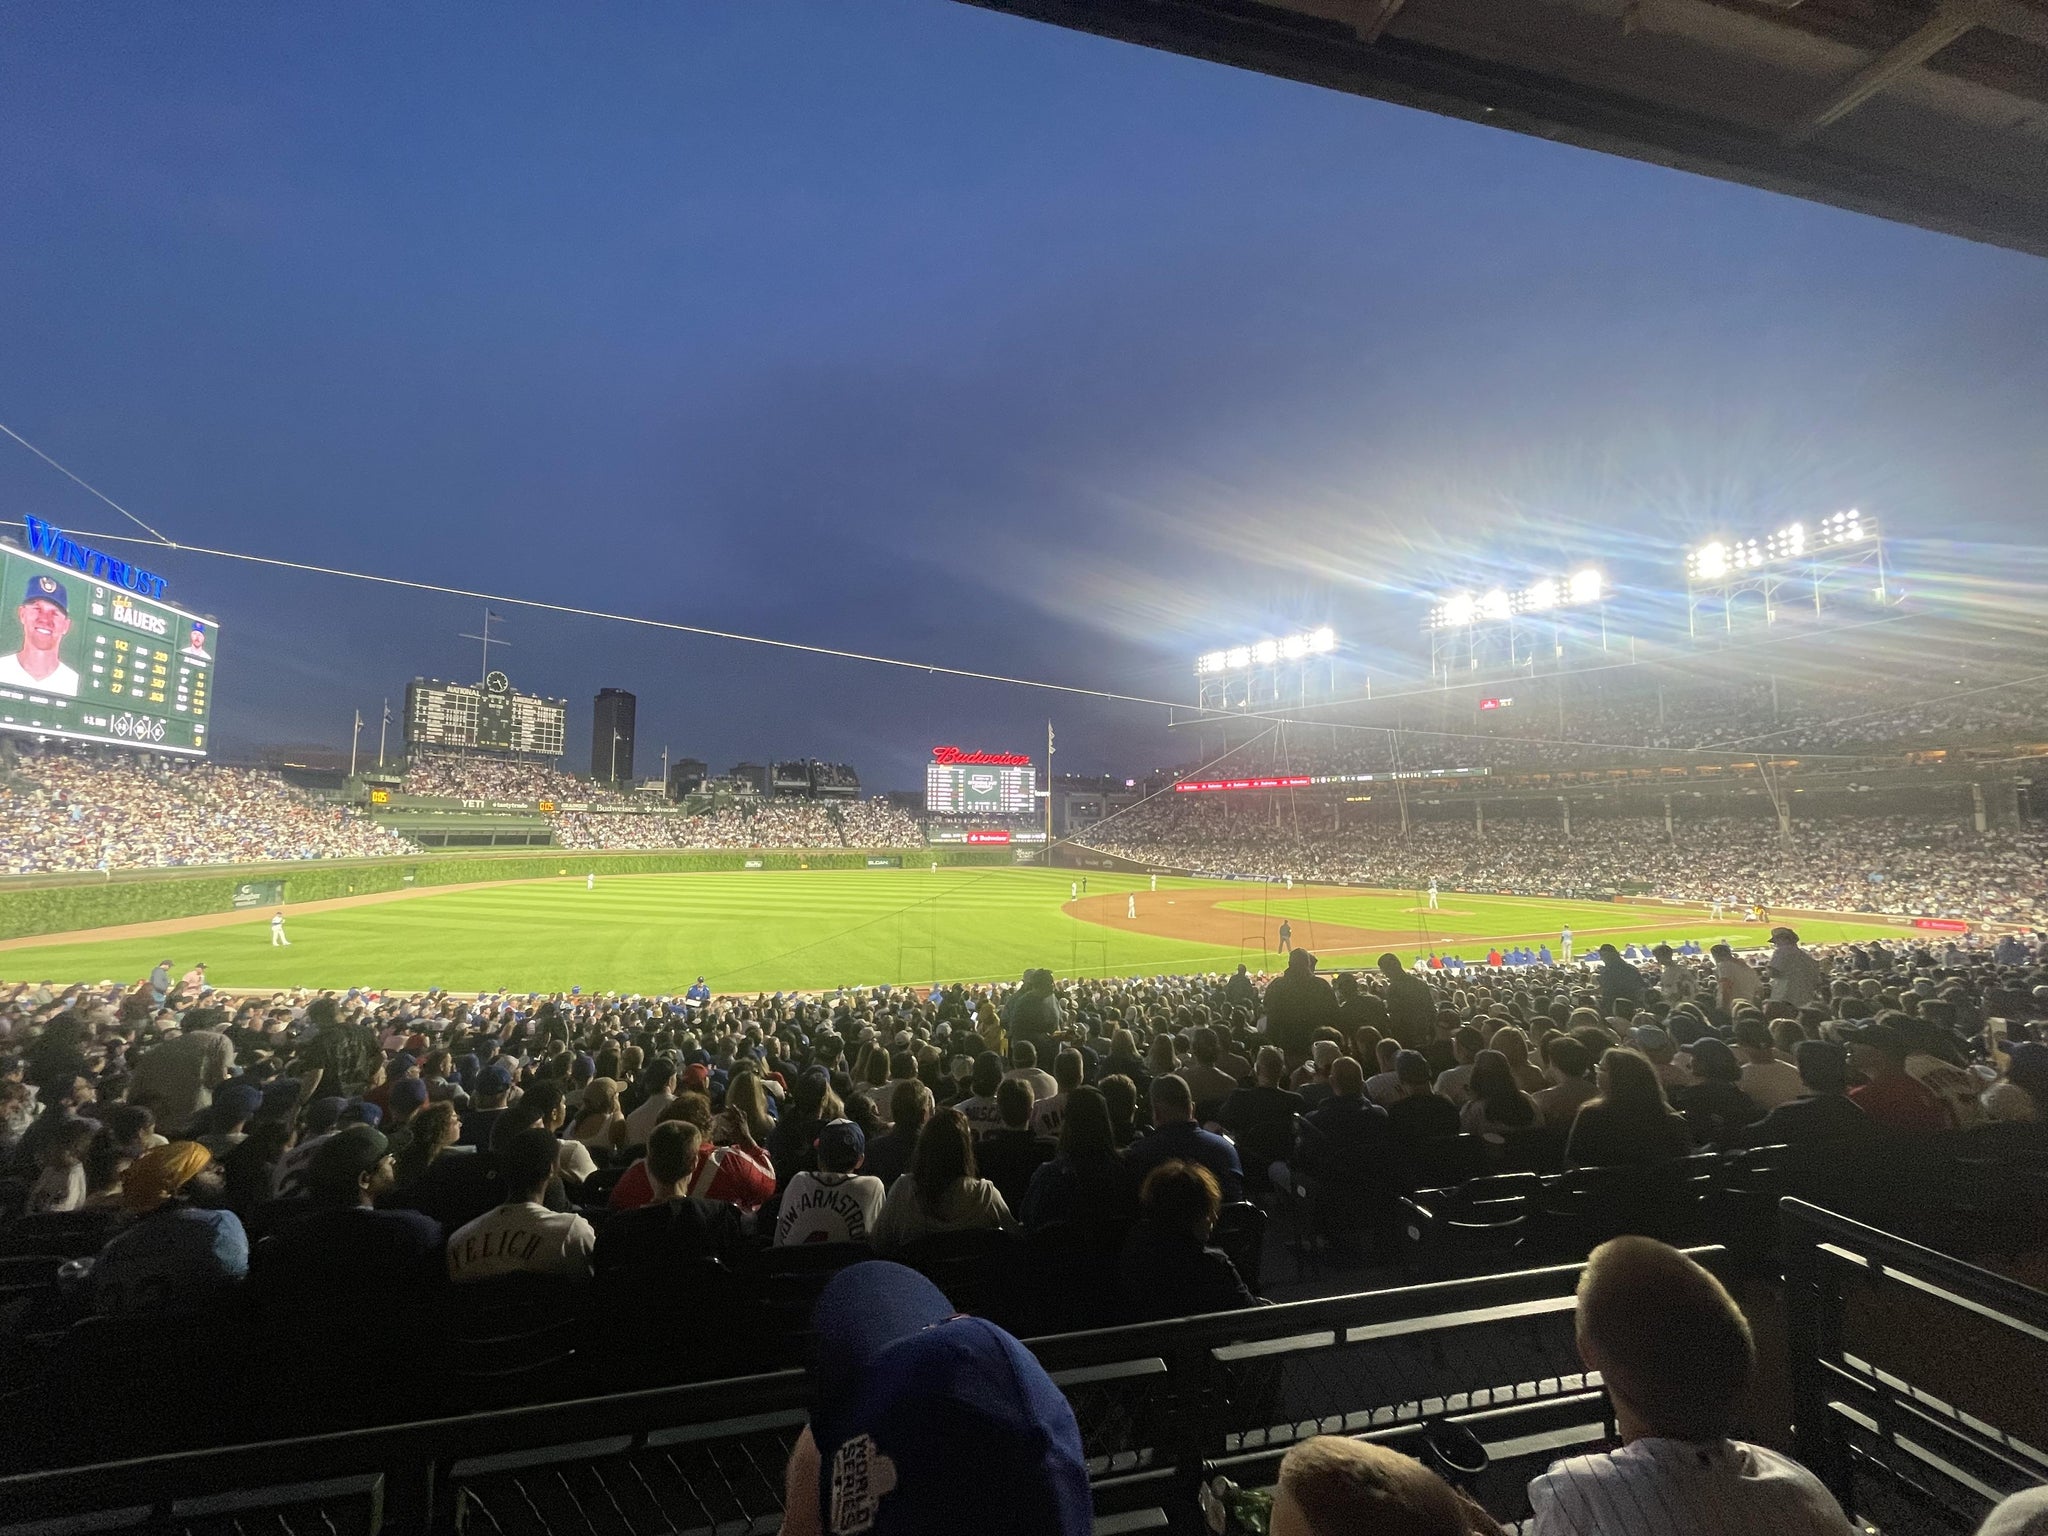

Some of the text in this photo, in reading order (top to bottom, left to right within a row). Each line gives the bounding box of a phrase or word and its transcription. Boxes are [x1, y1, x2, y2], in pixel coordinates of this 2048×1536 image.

[24, 513, 168, 600] WINTRUST
[96, 587, 104, 599] 9
[113, 606, 166, 635] BAUERS
[446, 686, 481, 696] NATIONAL
[512, 696, 542, 706] AMERICAN
[932, 746, 1030, 766] Budweiser
[461, 799, 484, 808] YETI
[596, 804, 636, 812] Budweiser
[980, 834, 1008, 842] Budweiser
[856, 1439, 870, 1522] WORLD
[842, 1444, 856, 1530] SERIES
